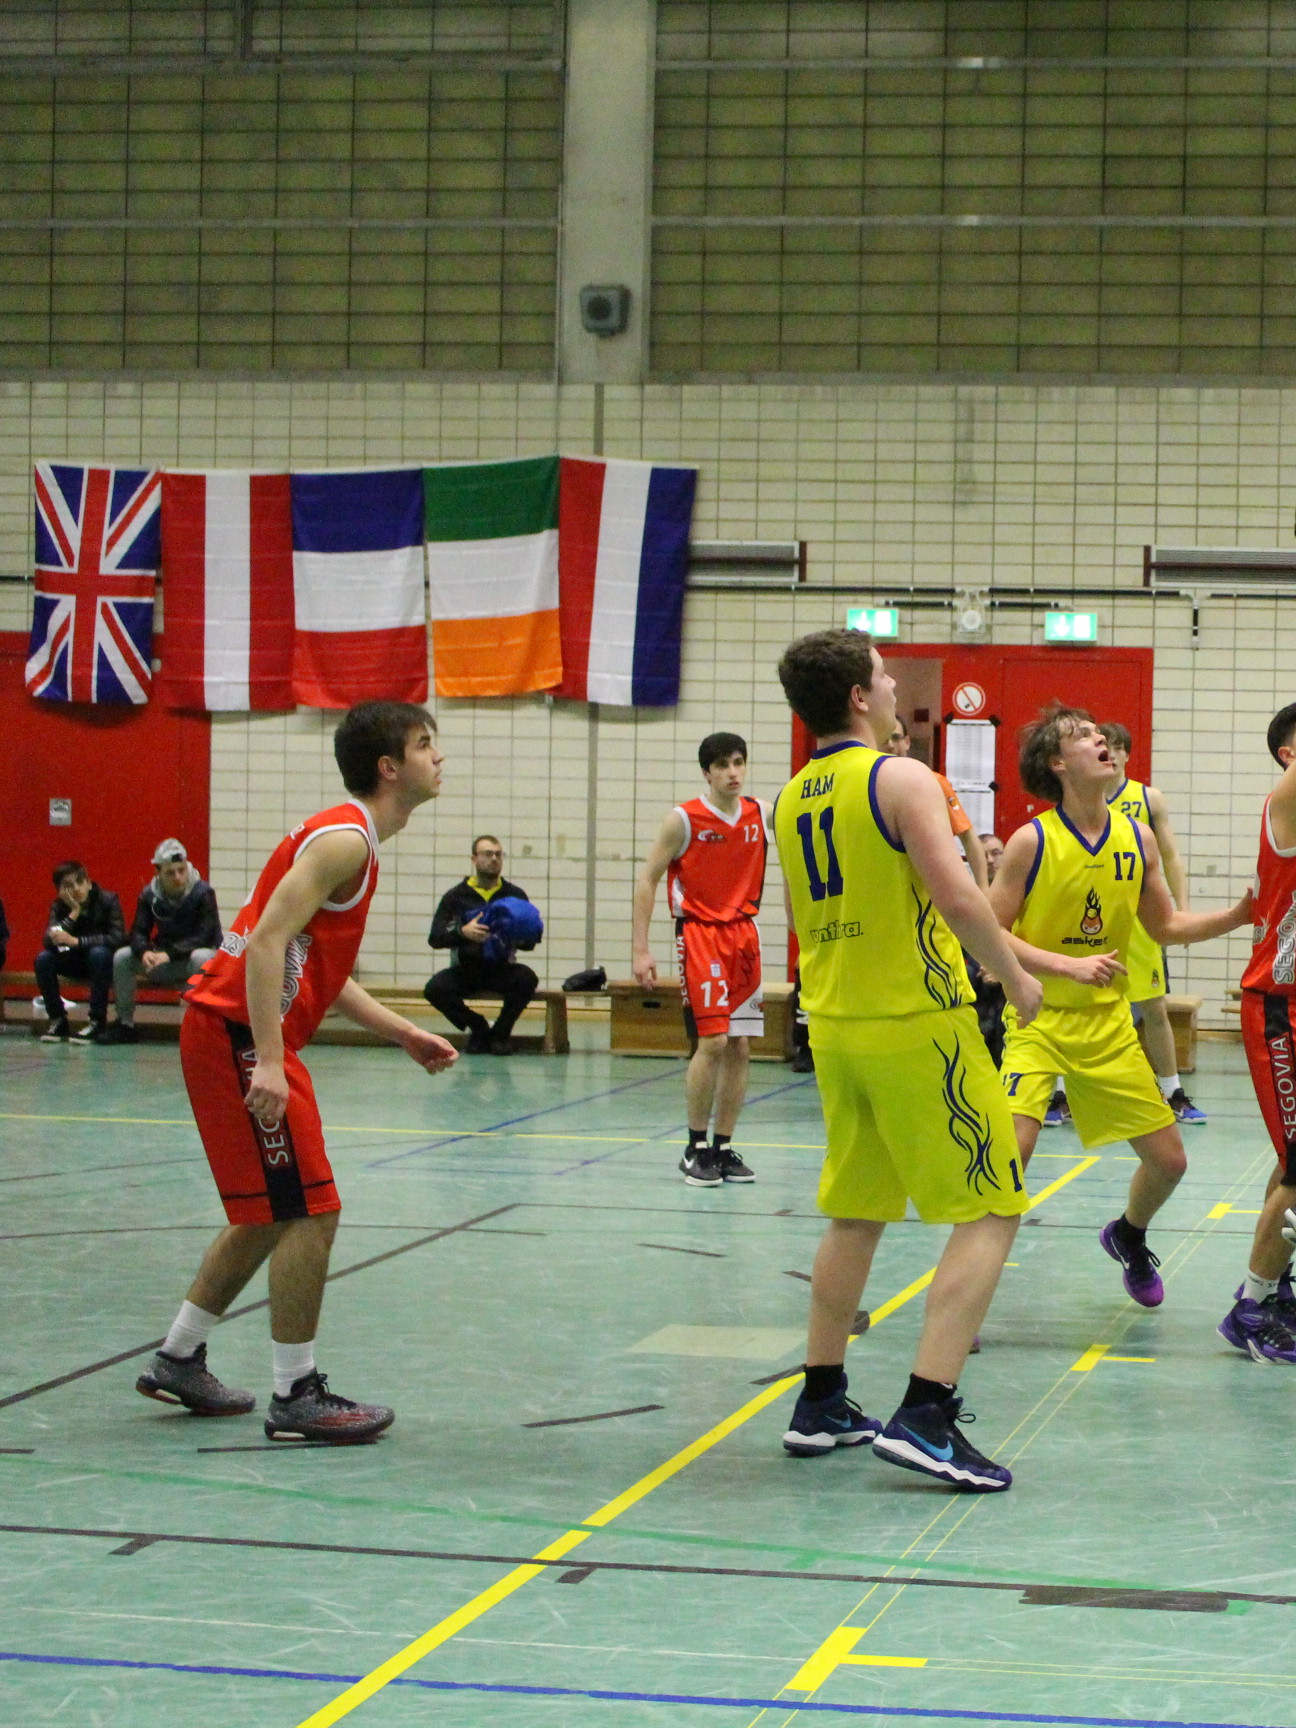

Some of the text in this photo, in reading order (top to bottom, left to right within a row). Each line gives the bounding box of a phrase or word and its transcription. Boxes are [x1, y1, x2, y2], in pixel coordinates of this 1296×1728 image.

[800, 773, 835, 799] HAM
[1121, 801, 1142, 818] 27
[743, 823, 759, 843] 12
[796, 806, 844, 902] 11
[1113, 851, 1136, 881] 17
[700, 979, 729, 1008] 12
